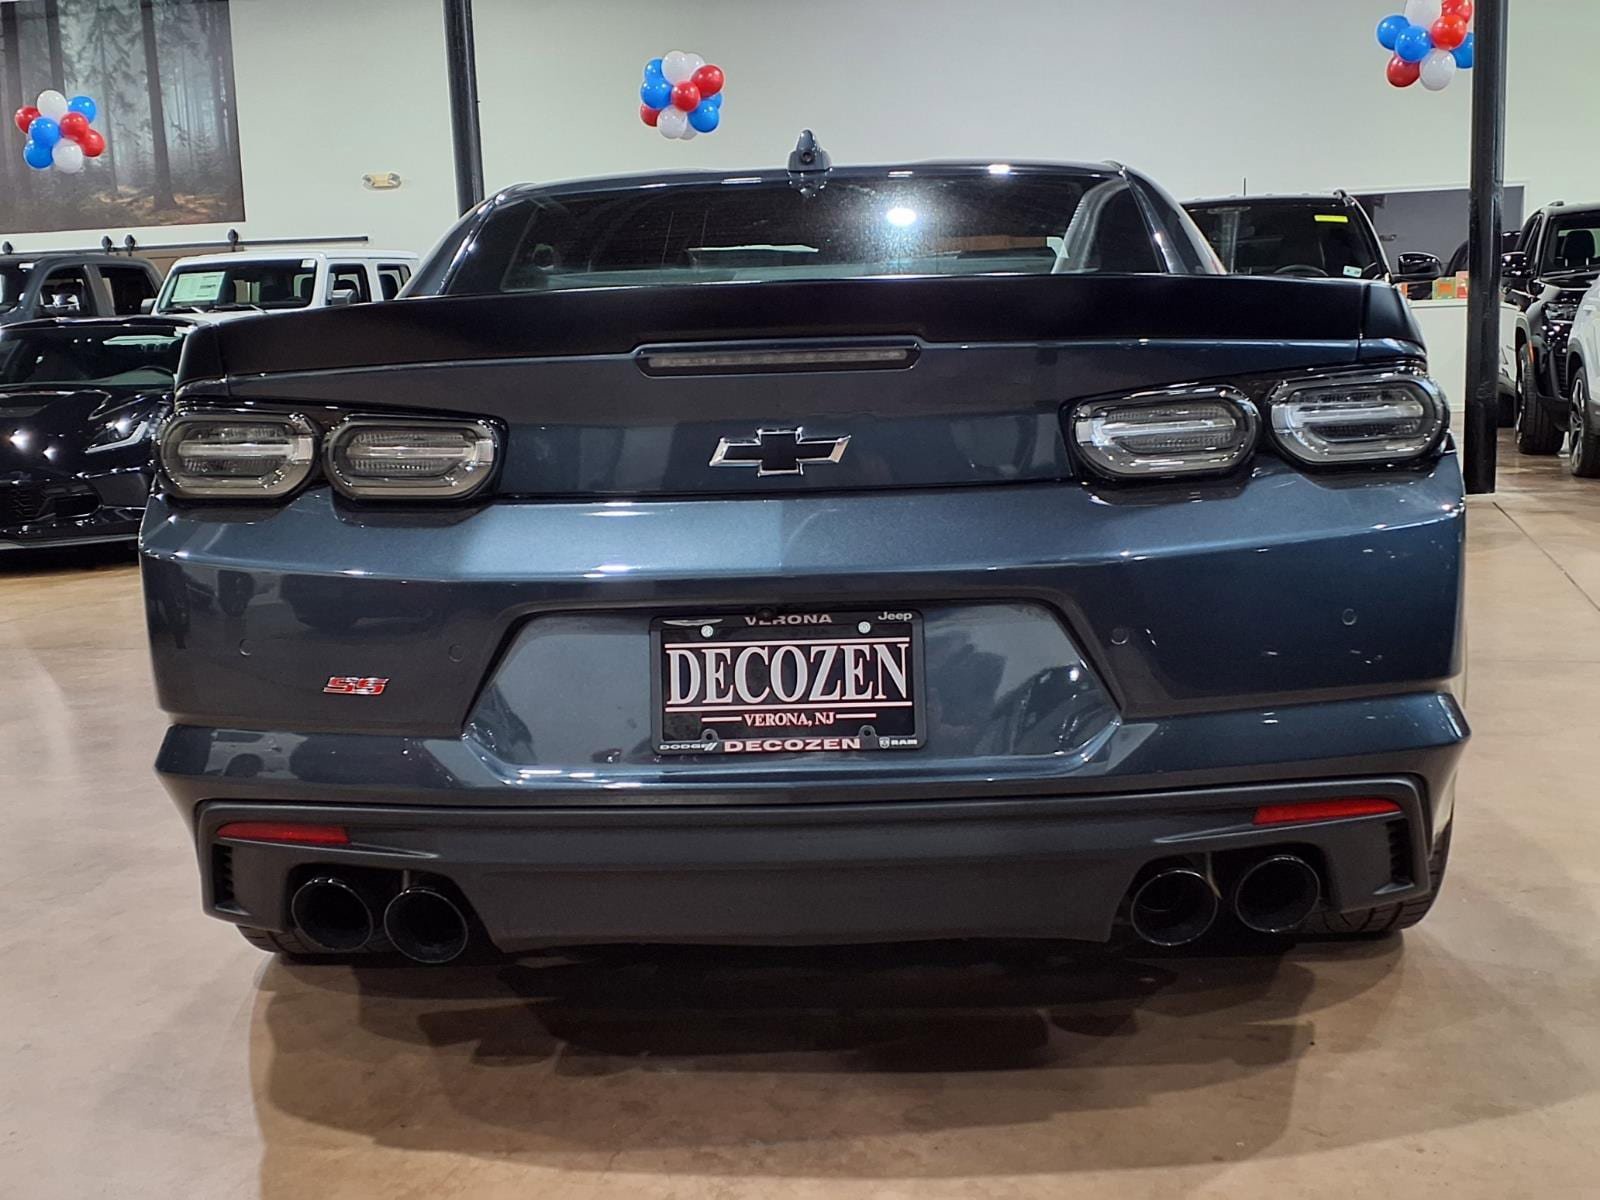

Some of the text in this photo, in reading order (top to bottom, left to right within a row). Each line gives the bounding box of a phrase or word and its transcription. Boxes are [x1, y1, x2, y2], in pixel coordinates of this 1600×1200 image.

[878, 611, 913, 622] Jeep
[665, 643, 909, 705] DECOZEN
[743, 711, 836, 728] VERONA, NJ
[724, 738, 861, 753] DECOZEN
